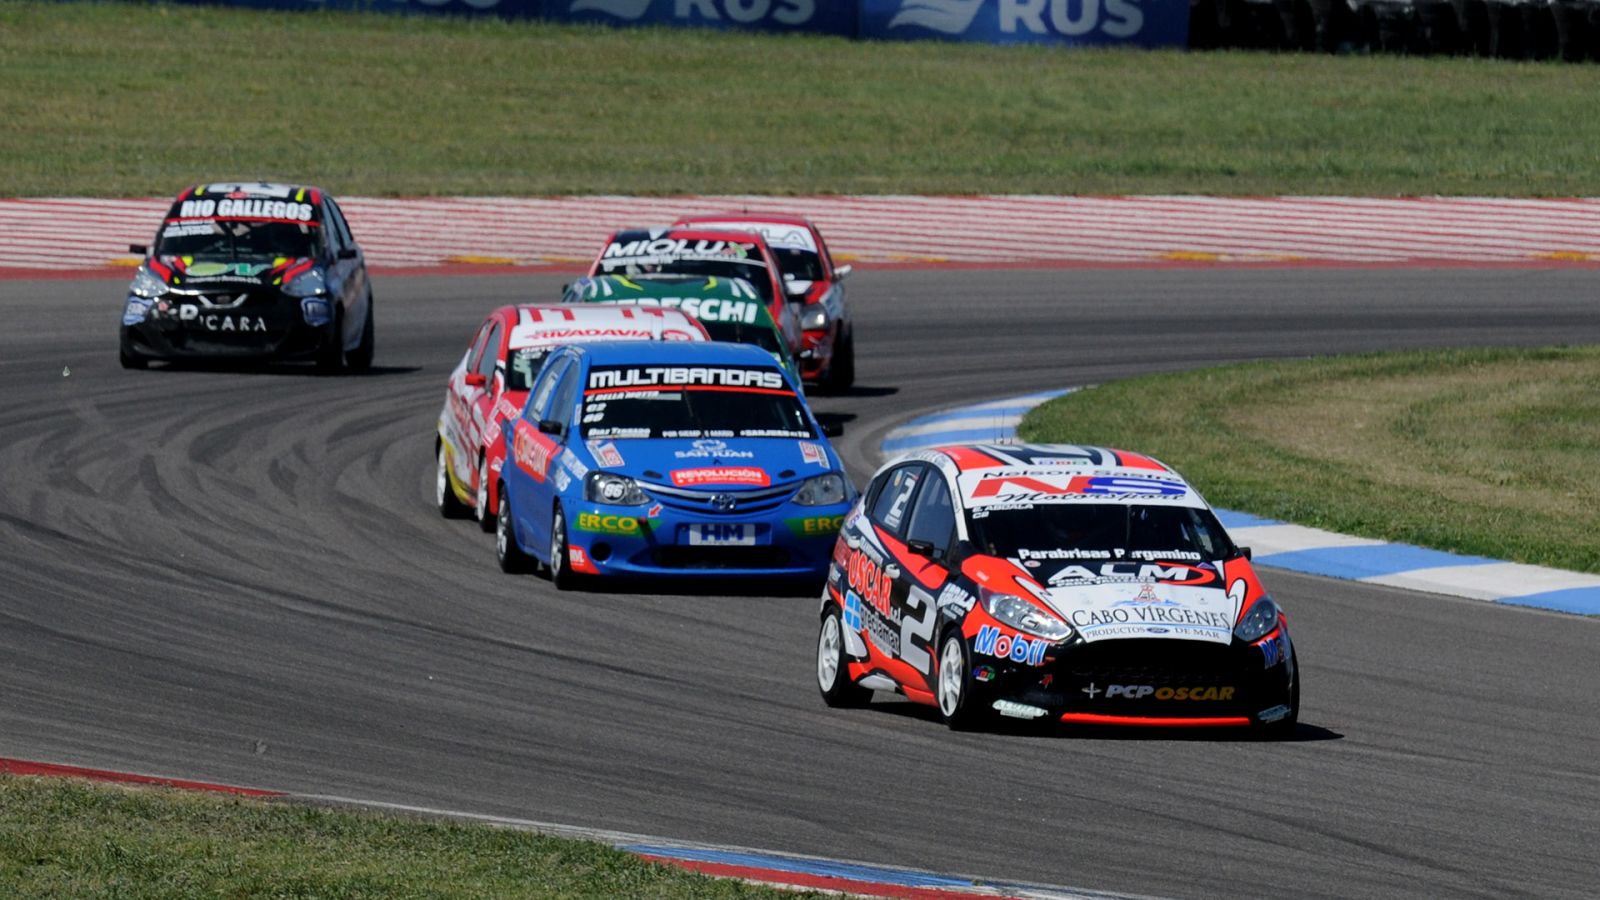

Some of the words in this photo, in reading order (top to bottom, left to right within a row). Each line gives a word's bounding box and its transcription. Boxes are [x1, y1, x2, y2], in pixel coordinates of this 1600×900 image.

[999, 0, 1144, 37] RUS
[180, 199, 216, 217] RIO
[217, 199, 313, 221] GALLEGOS
[589, 367, 783, 389] MULTIBANDAS
[675, 450, 709, 458] SAN
[711, 449, 754, 458] JUAN
[676, 468, 762, 479] REVOLUCIÓN
[983, 470, 1082, 479] Nelson
[603, 483, 623, 497] 86
[997, 492, 1186, 503] Motorsport
[579, 512, 639, 531] ERCO
[701, 524, 745, 541] HM
[1018, 549, 1111, 560] Parabrisas
[1114, 549, 1201, 561] Prgamino
[848, 549, 892, 619] OSCAR
[1072, 608, 1129, 626] CABO
[1132, 606, 1231, 630] VÍRGENES
[899, 584, 937, 675] 2
[1086, 626, 1146, 639] PRODUCTOS
[1174, 627, 1191, 636] DE
[1193, 628, 1220, 639] MAR
[974, 624, 1049, 667] Mobil
[1105, 684, 1154, 698] PCP
[1154, 686, 1236, 700] OSCAR
